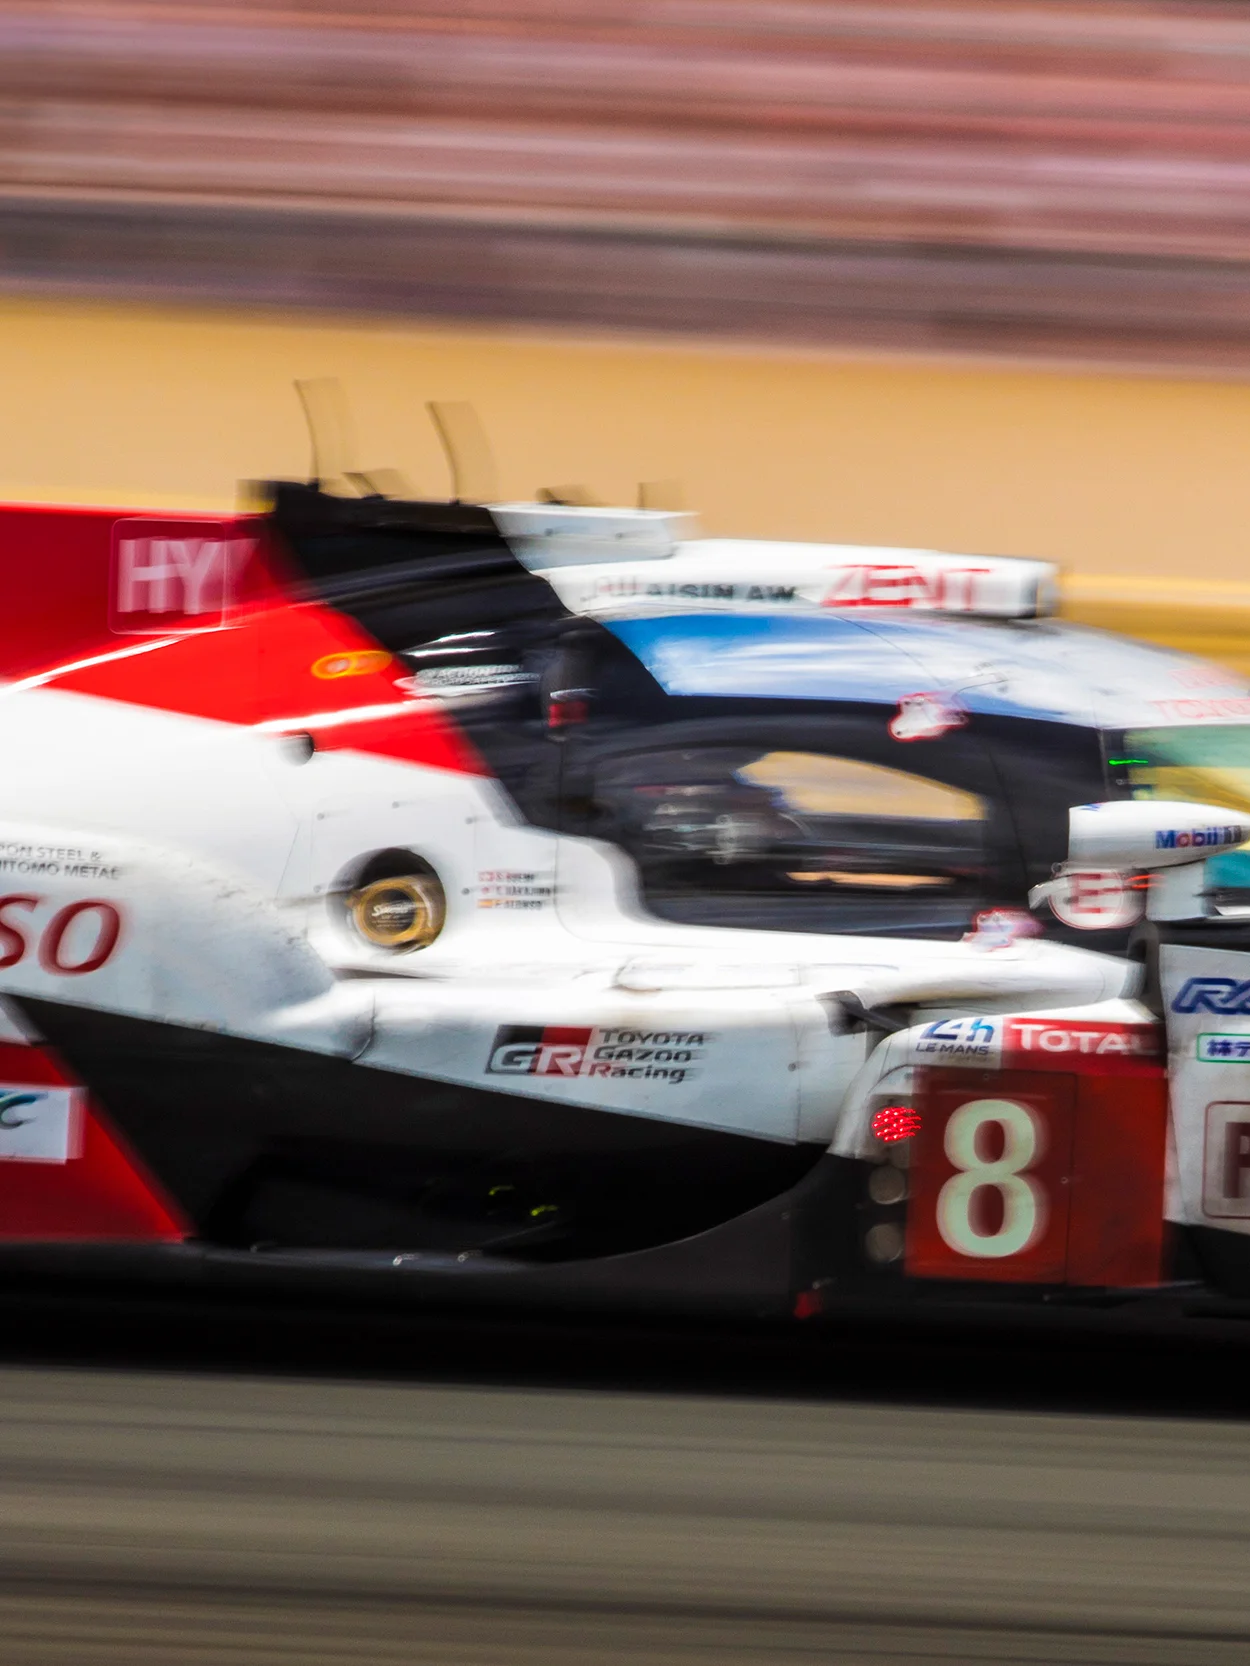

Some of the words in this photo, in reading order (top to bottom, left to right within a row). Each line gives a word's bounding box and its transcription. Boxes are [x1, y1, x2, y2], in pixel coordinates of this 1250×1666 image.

[117, 537, 260, 615] HY
[821, 564, 994, 610] ZENT
[1155, 827, 1220, 848] Mobil
[36, 846, 84, 861] STEEL
[600, 1028, 705, 1046] TOYOTA
[490, 1044, 583, 1076] GR
[594, 1047, 693, 1062] GAZOO
[915, 1043, 936, 1053] LE
[941, 1045, 990, 1056] MANS
[588, 1063, 686, 1084] Racing
[936, 1099, 1046, 1258] 8
